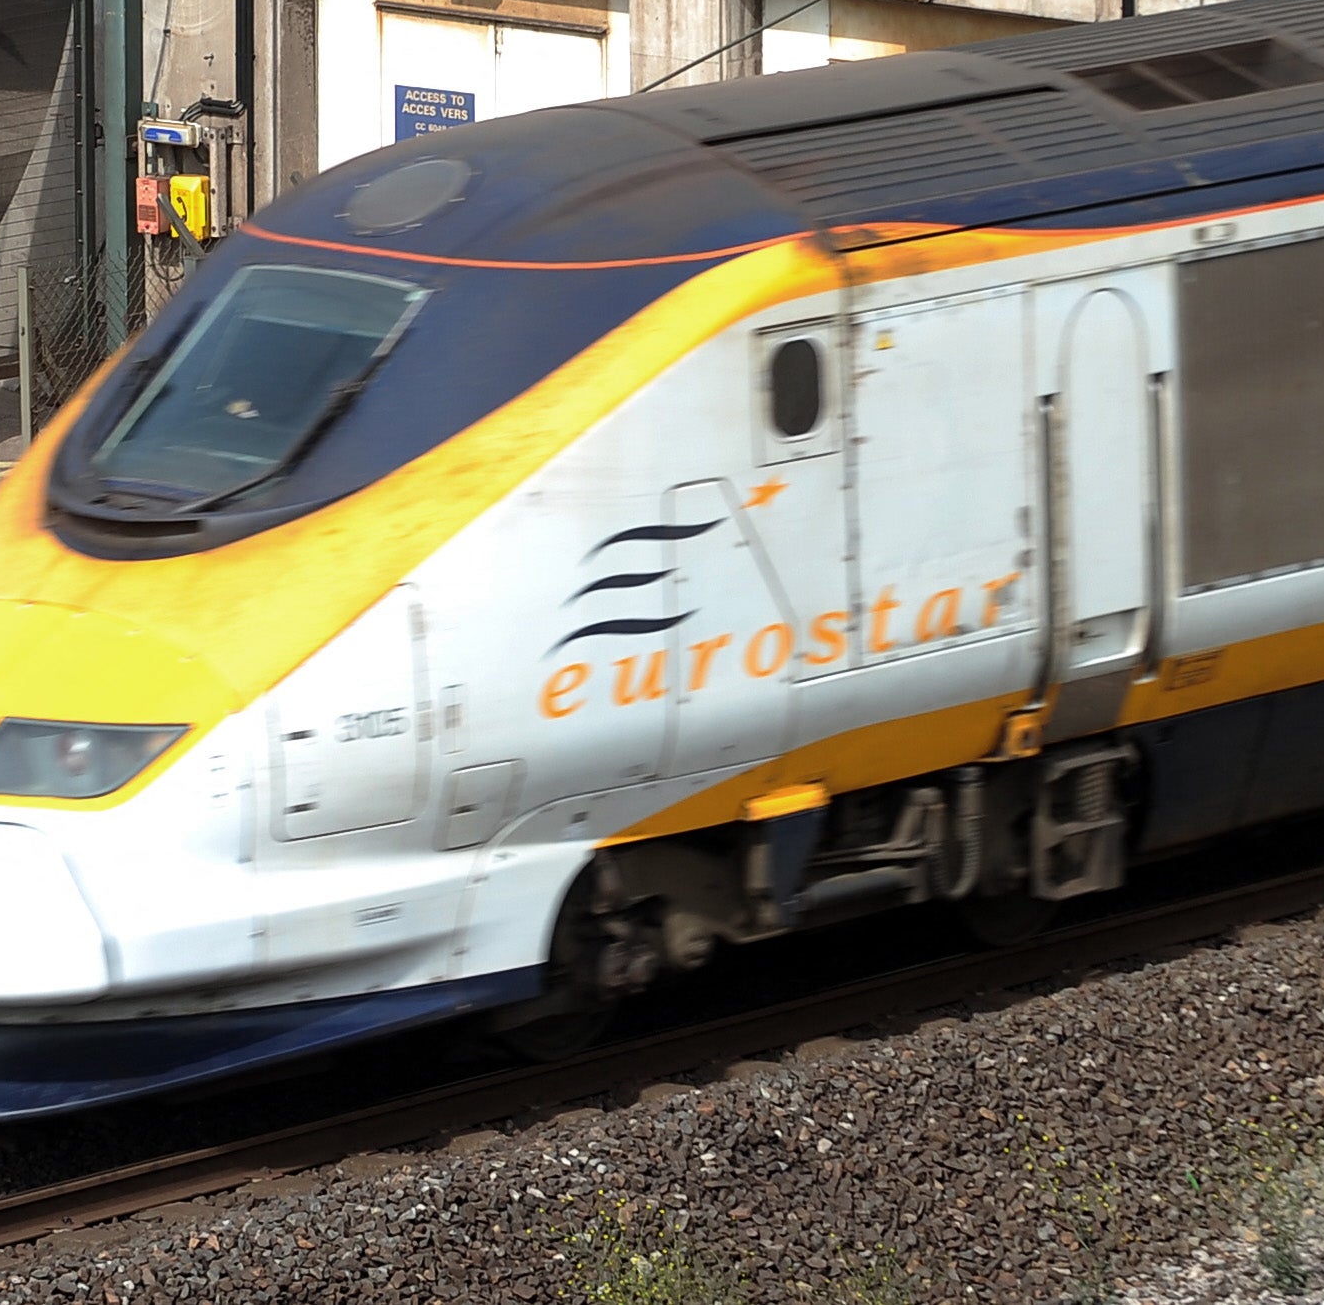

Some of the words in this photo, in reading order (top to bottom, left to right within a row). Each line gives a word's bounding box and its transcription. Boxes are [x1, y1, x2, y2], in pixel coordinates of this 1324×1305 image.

[406, 90, 446, 104] ACCESS
[451, 95, 465, 106] TO
[402, 103, 436, 116] ACCES
[441, 108, 468, 120] VERS
[537, 570, 1023, 721] eurostar
